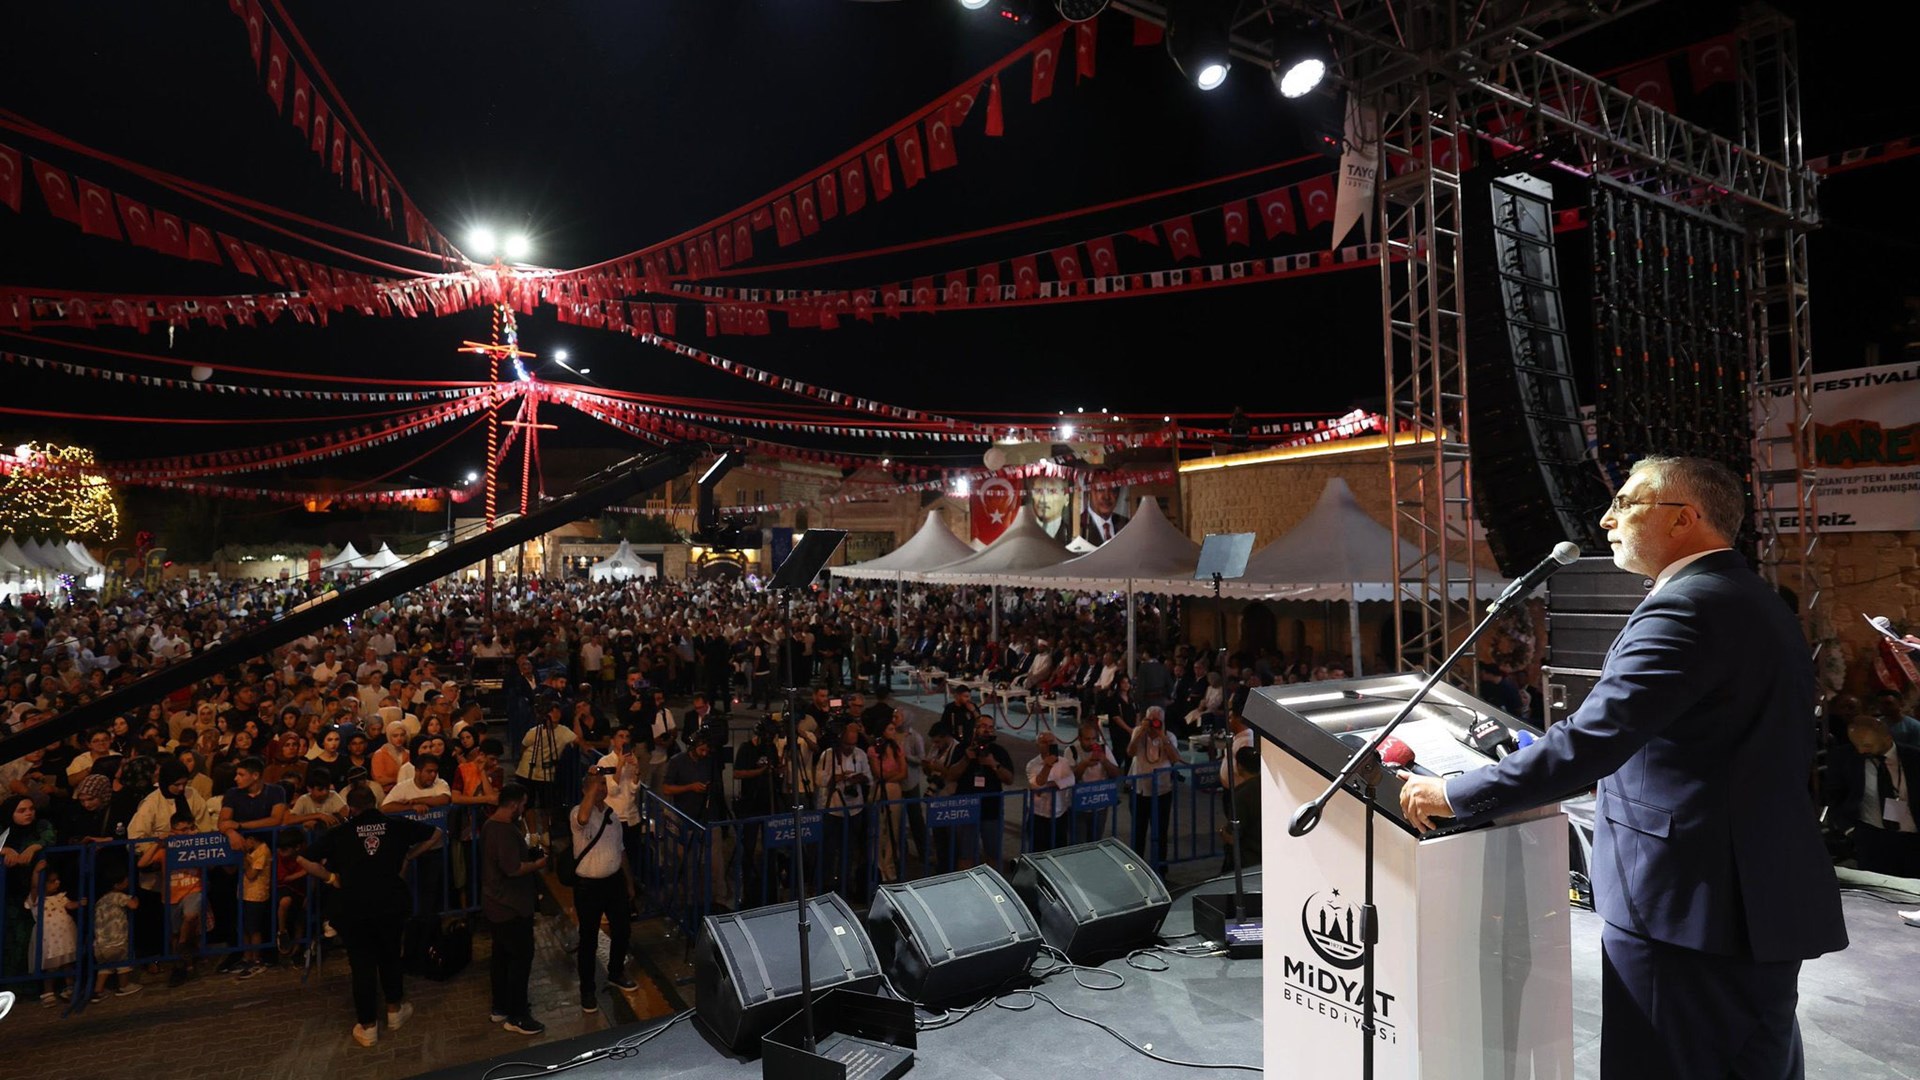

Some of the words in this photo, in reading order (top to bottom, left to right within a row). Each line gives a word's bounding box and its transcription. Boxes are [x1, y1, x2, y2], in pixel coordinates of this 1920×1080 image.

[936, 809, 970, 821] ZABITA
[775, 827, 812, 841] ZABTA
[178, 848, 226, 862] ZABITA
